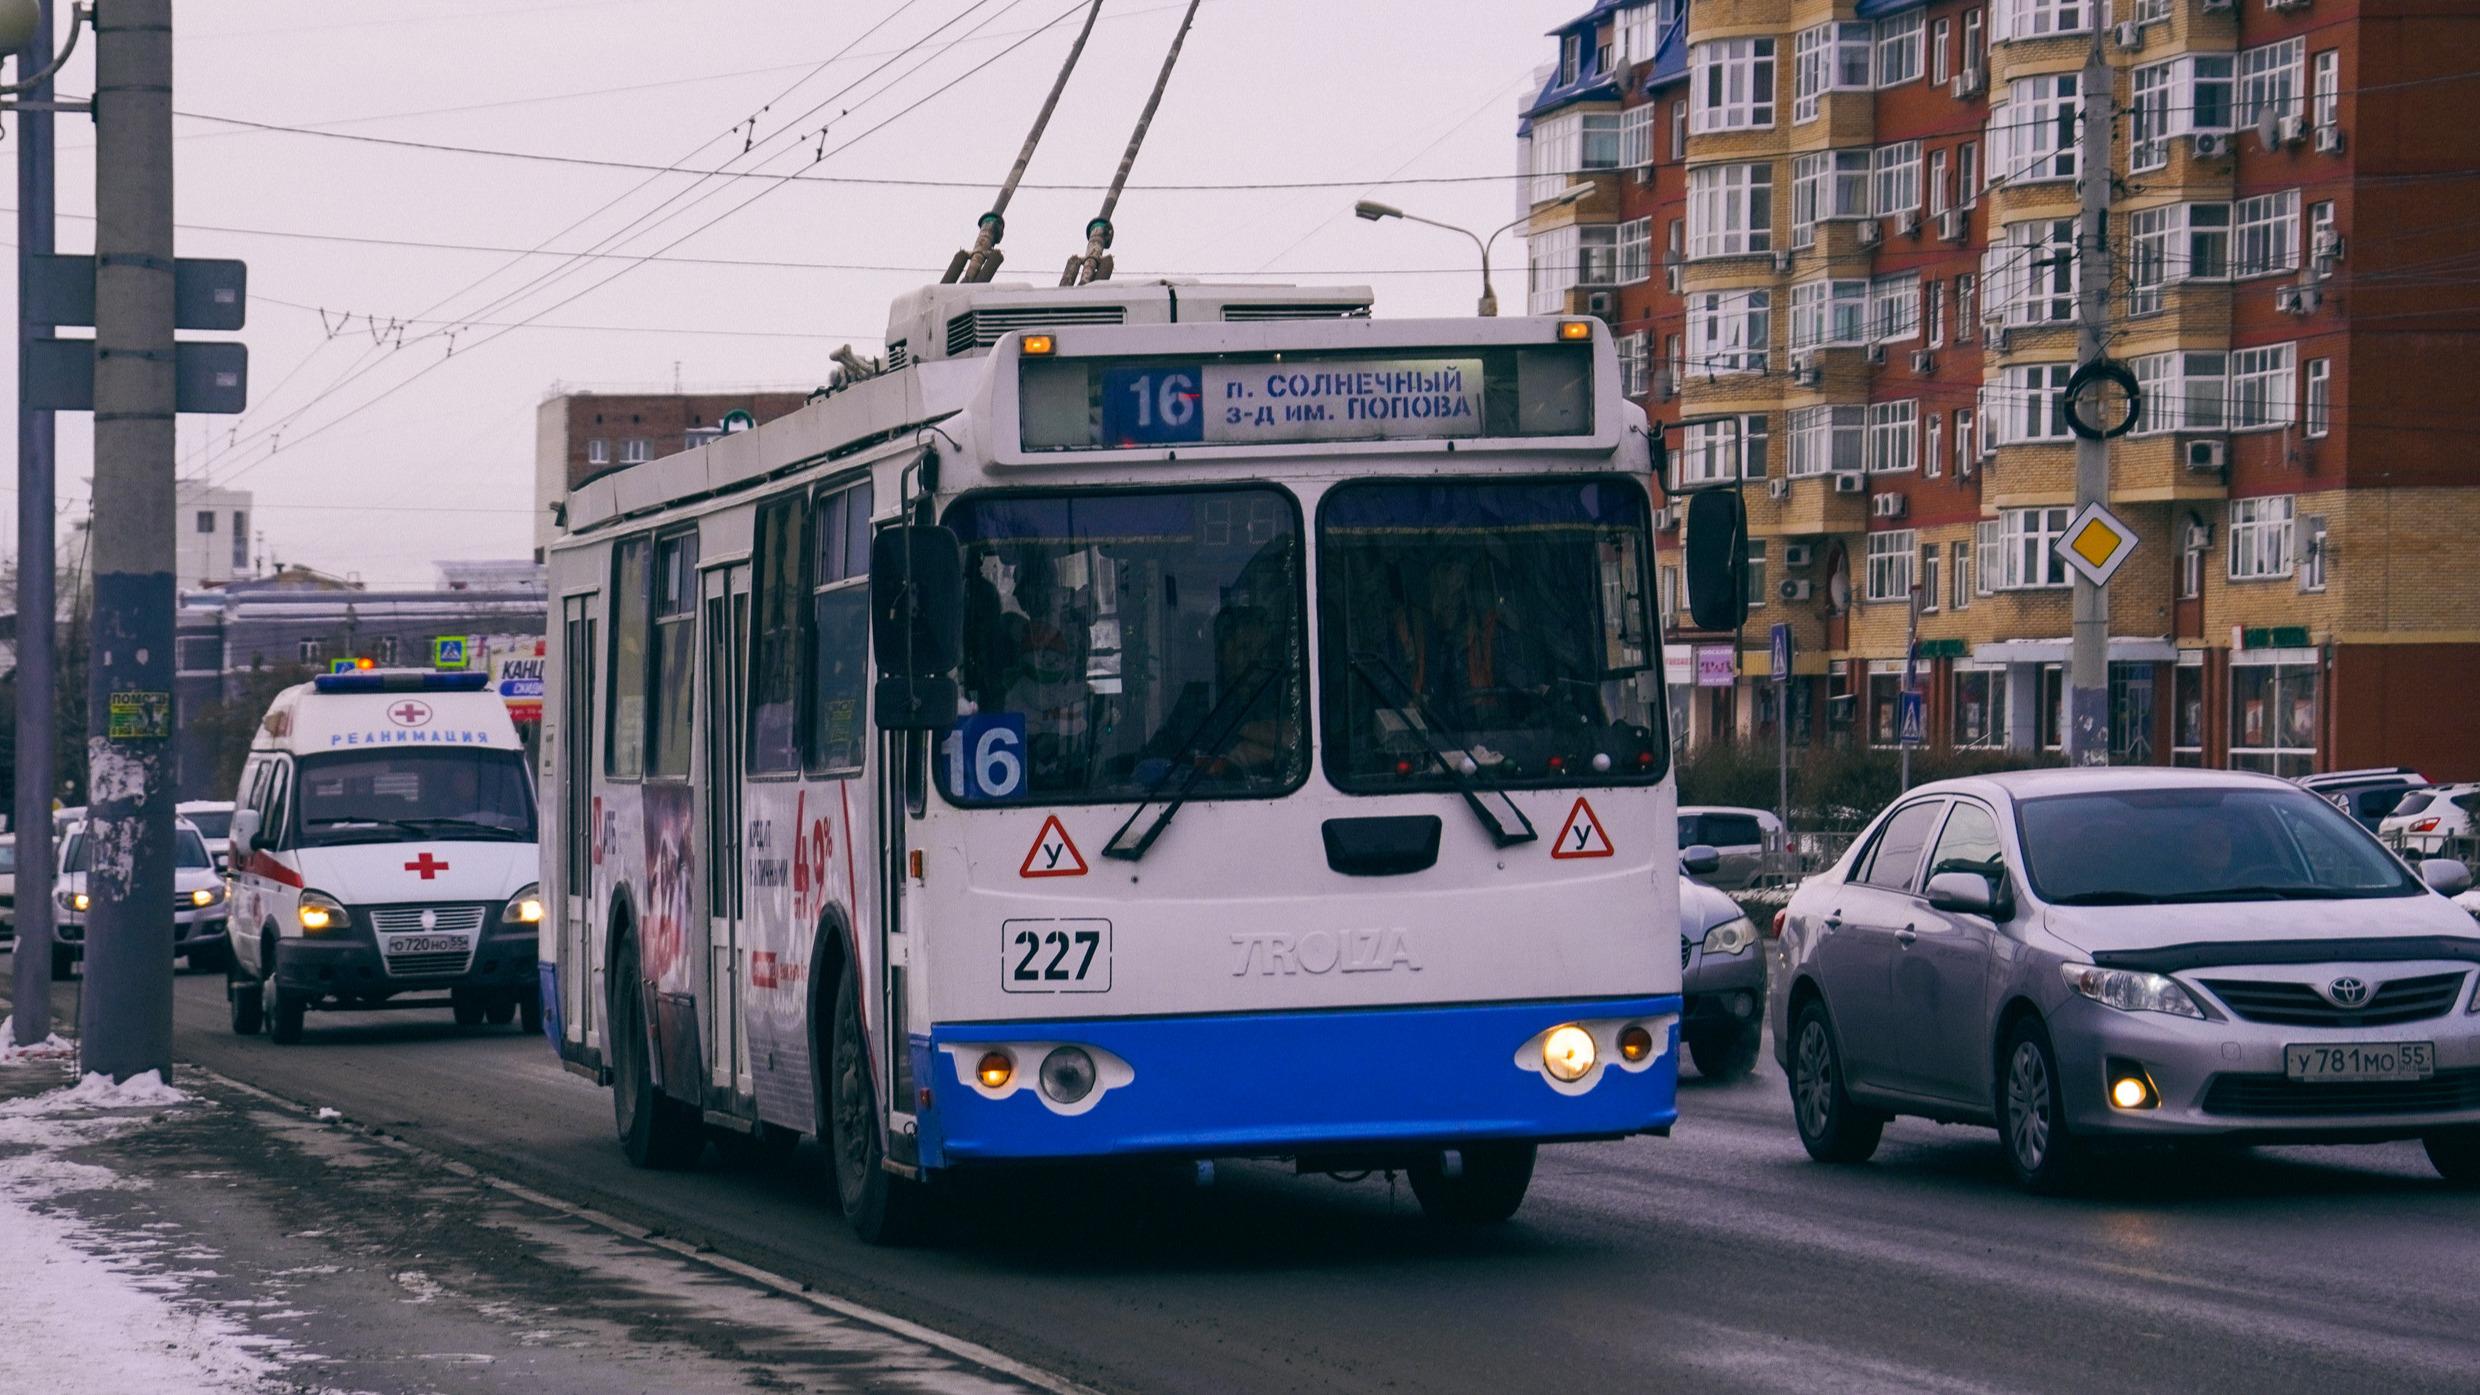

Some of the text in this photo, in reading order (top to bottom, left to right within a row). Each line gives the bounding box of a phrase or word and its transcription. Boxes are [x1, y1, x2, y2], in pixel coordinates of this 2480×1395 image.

[1129, 374, 1194, 426] 16
[1266, 365, 1463, 397] СОЛНЕЧНЫЙ
[1225, 395, 1472, 426] з-д им. ПОПОВА
[331, 729, 490, 746] РЕАНИМАЦИЯ
[940, 727, 1021, 797] 16
[1013, 930, 1101, 981] 227
[1230, 927, 1423, 977] TROLZA
[2402, 1046, 2424, 1065] 55
